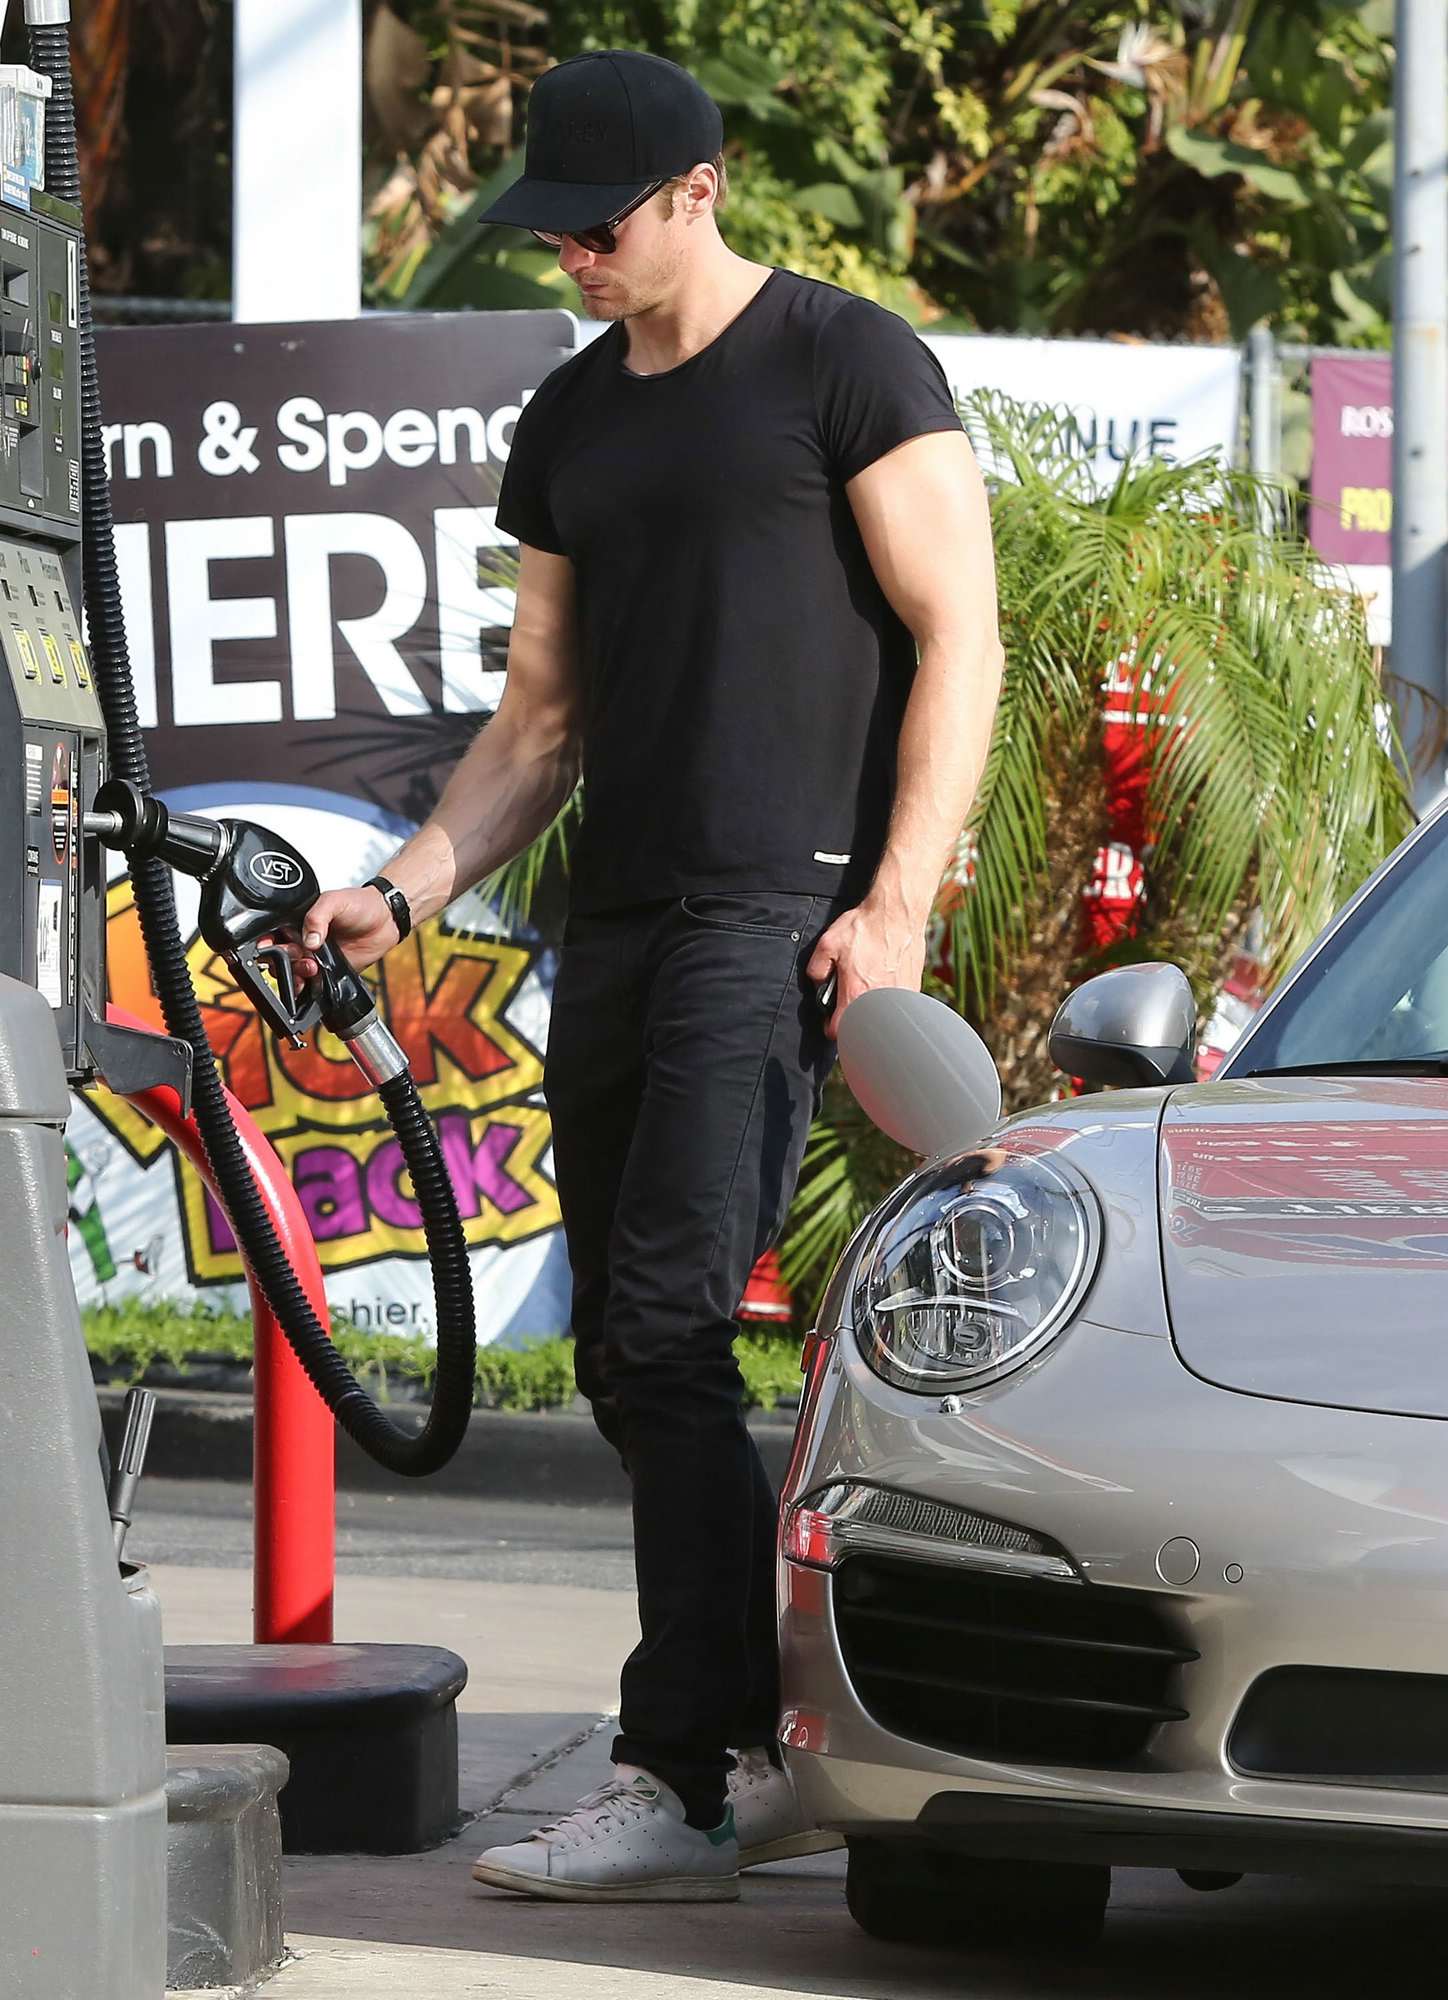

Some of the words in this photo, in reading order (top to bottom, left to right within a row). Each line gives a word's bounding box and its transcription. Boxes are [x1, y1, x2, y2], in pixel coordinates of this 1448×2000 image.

[199, 401, 261, 476] &
[260, 857, 293, 882] VST
[203, 1113, 536, 1255] ack
